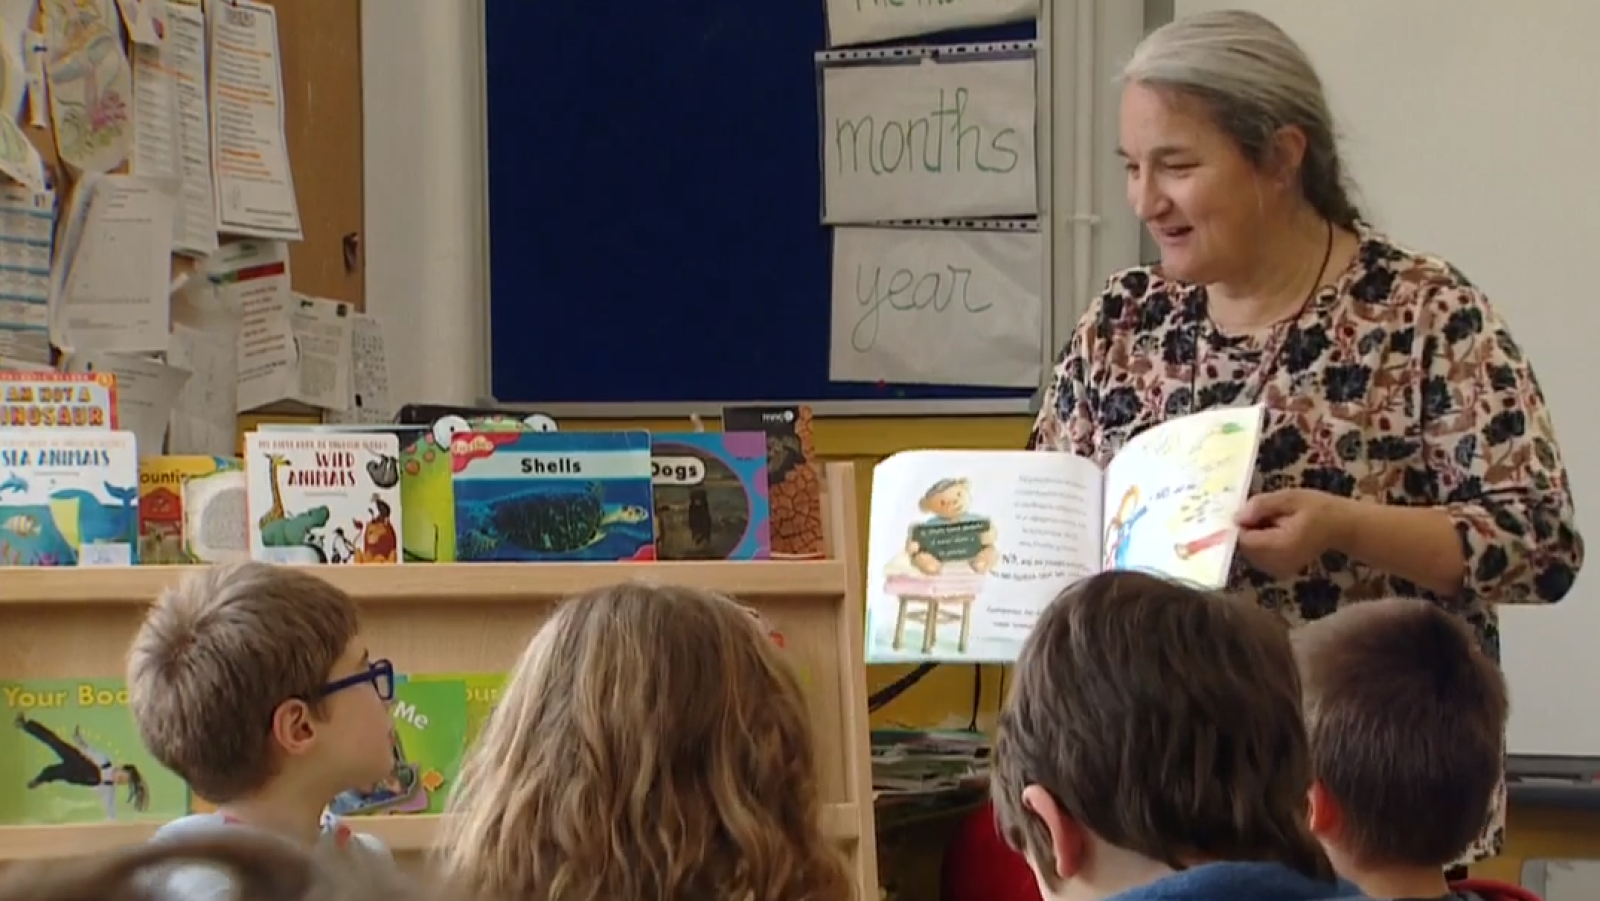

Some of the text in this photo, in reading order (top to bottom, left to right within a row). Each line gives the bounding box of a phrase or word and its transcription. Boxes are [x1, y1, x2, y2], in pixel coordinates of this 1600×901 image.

[836, 87, 1018, 174] months
[851, 263, 993, 352] year
[5, 386, 92, 402] AM NOT A
[0, 404, 104, 427] INOSAUR
[1, 450, 110, 466] SEA ANIMALS
[316, 451, 355, 467] WILD
[521, 457, 582, 474] Shells
[139, 468, 188, 484] ounti
[288, 469, 356, 487] ANIMALS
[3, 686, 68, 707] Your
[393, 701, 429, 730] Me
